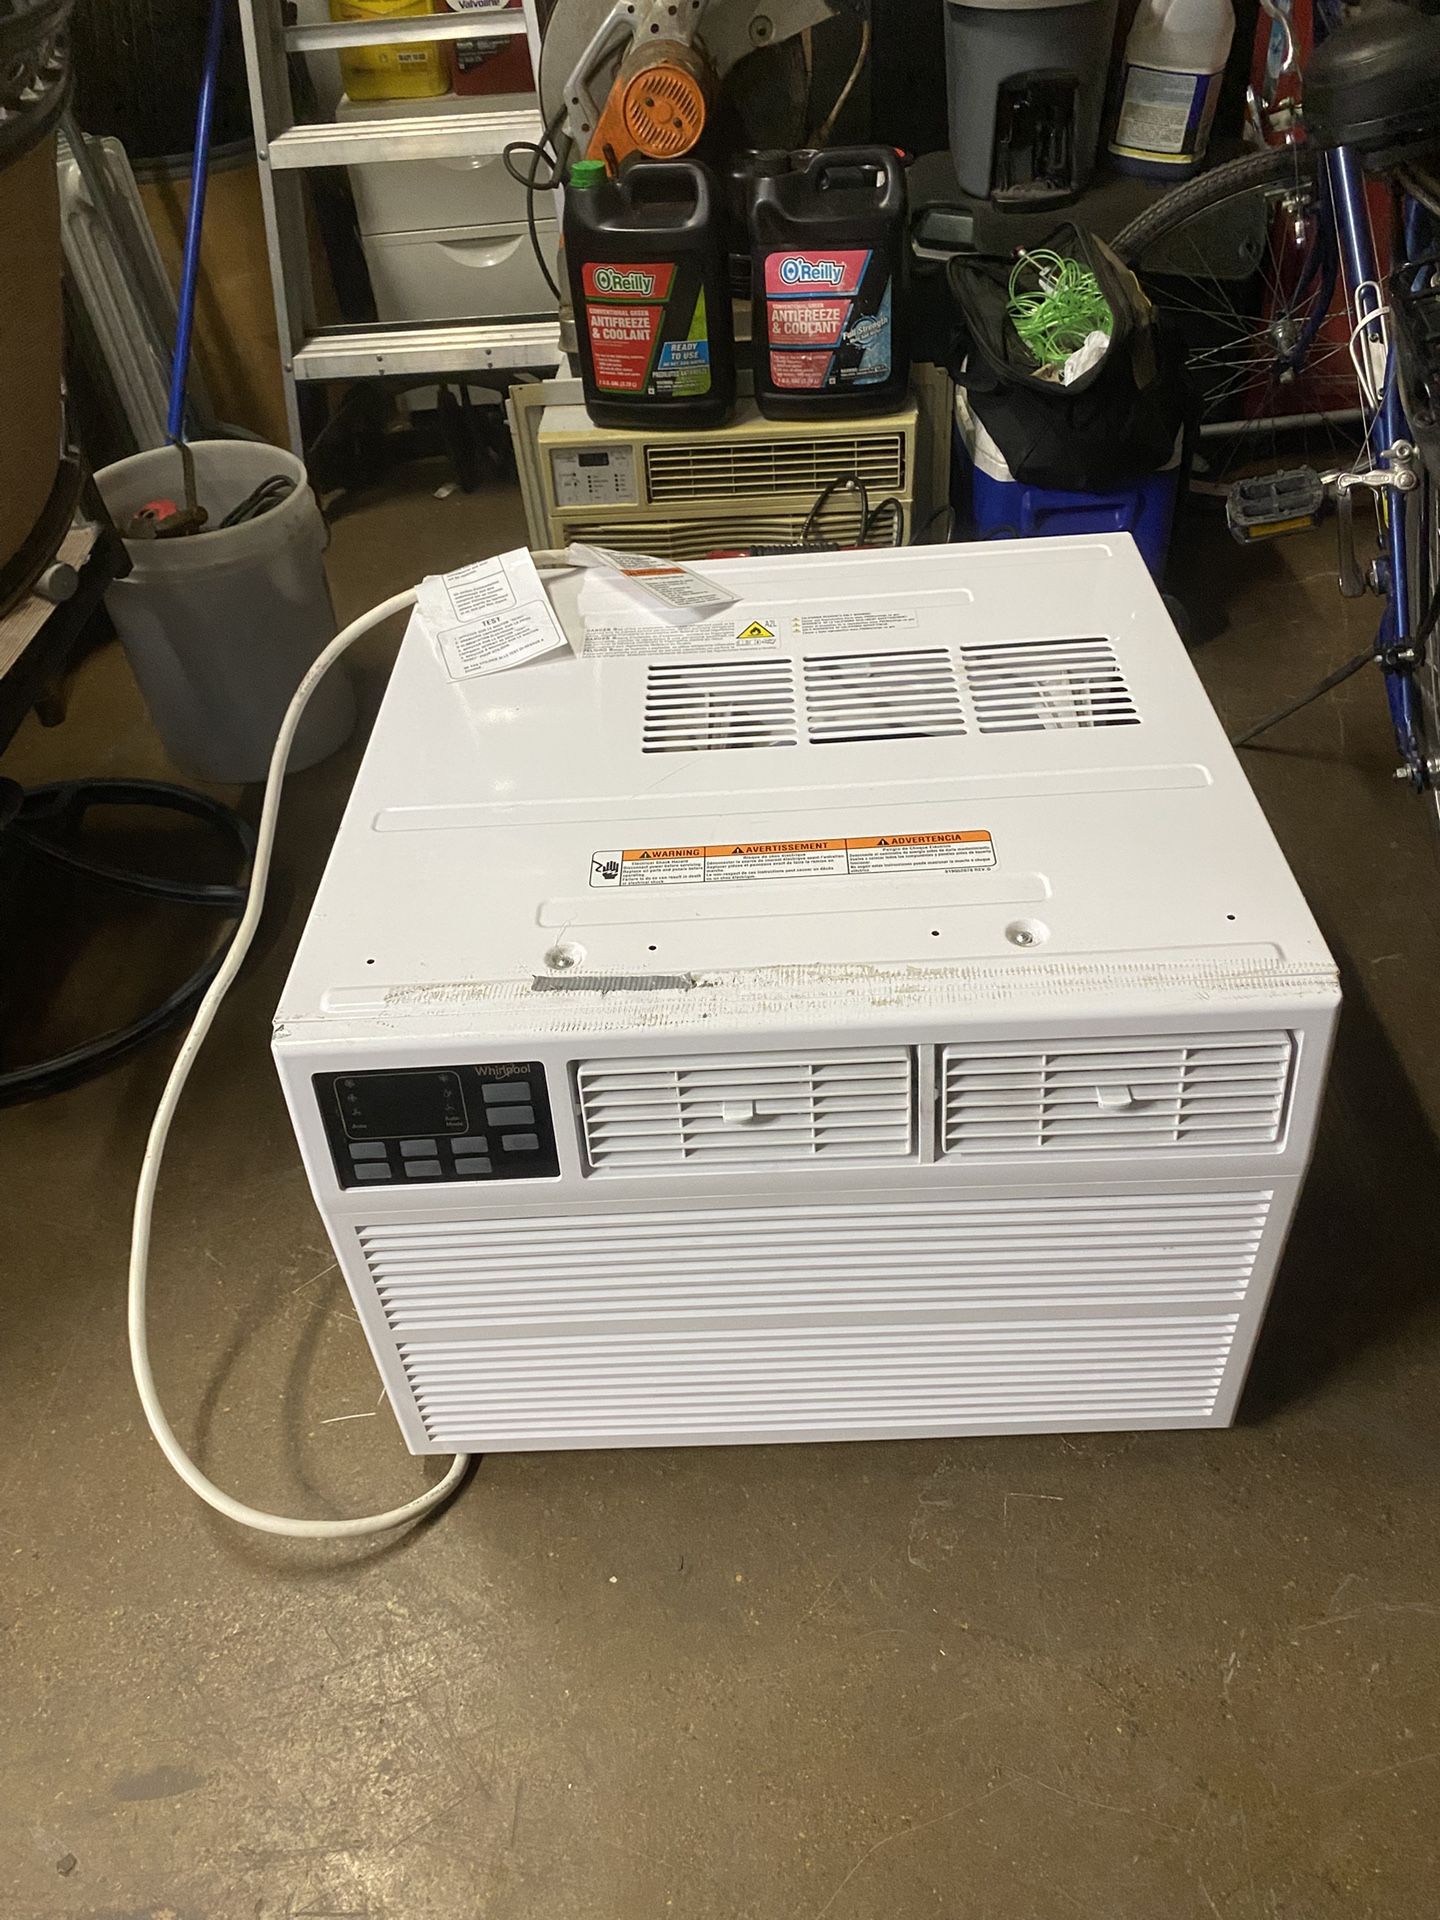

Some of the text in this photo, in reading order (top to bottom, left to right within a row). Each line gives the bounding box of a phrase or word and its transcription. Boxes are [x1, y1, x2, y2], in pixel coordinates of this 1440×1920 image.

[782, 258, 842, 284] O'Reilly
[595, 267, 653, 294] O'Reilly
[772, 309, 840, 321] ANTIFREEZE
[592, 316, 650, 328] ANTIFREEZE
[772, 321, 838, 334] & COOLANT
[858, 314, 888, 334] Strength
[592, 328, 650, 340] & COOLANT
[482, 617, 500, 626] TEST
[892, 834, 962, 844] ADVERTENCIA
[746, 842, 828, 852] AVERTISSEMENT
[474, 1064, 531, 1079] Whirlpool
